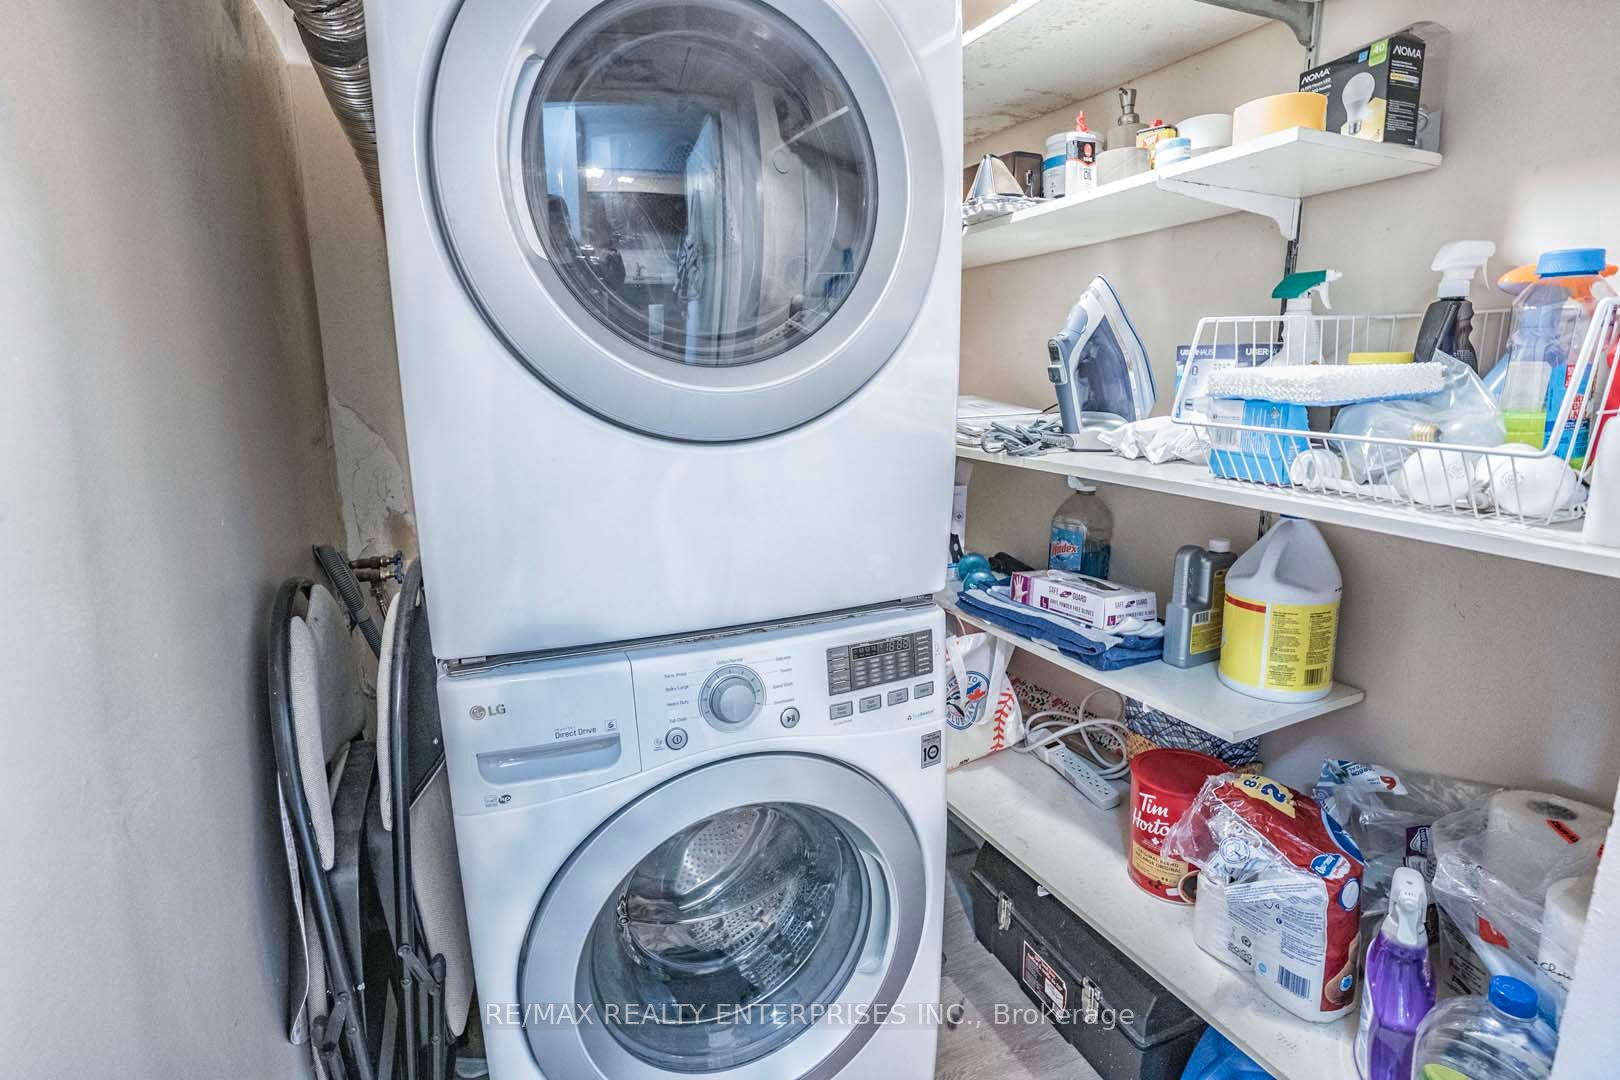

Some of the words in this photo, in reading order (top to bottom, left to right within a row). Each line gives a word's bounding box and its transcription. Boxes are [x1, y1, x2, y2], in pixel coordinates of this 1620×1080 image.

[1392, 44, 1422, 59] NOMA
[1300, 67, 1330, 85] NOMA
[1048, 585, 1059, 595] SAFE
[1072, 591, 1087, 603] GUARD
[487, 704, 506, 716] LG
[554, 730, 577, 740] Direct
[577, 727, 597, 737] Drive
[922, 744, 940, 762] 10
[1243, 779, 1257, 788] 8
[1261, 783, 1287, 803] 2
[1138, 791, 1168, 817] Tim
[1132, 807, 1170, 836] Horto
